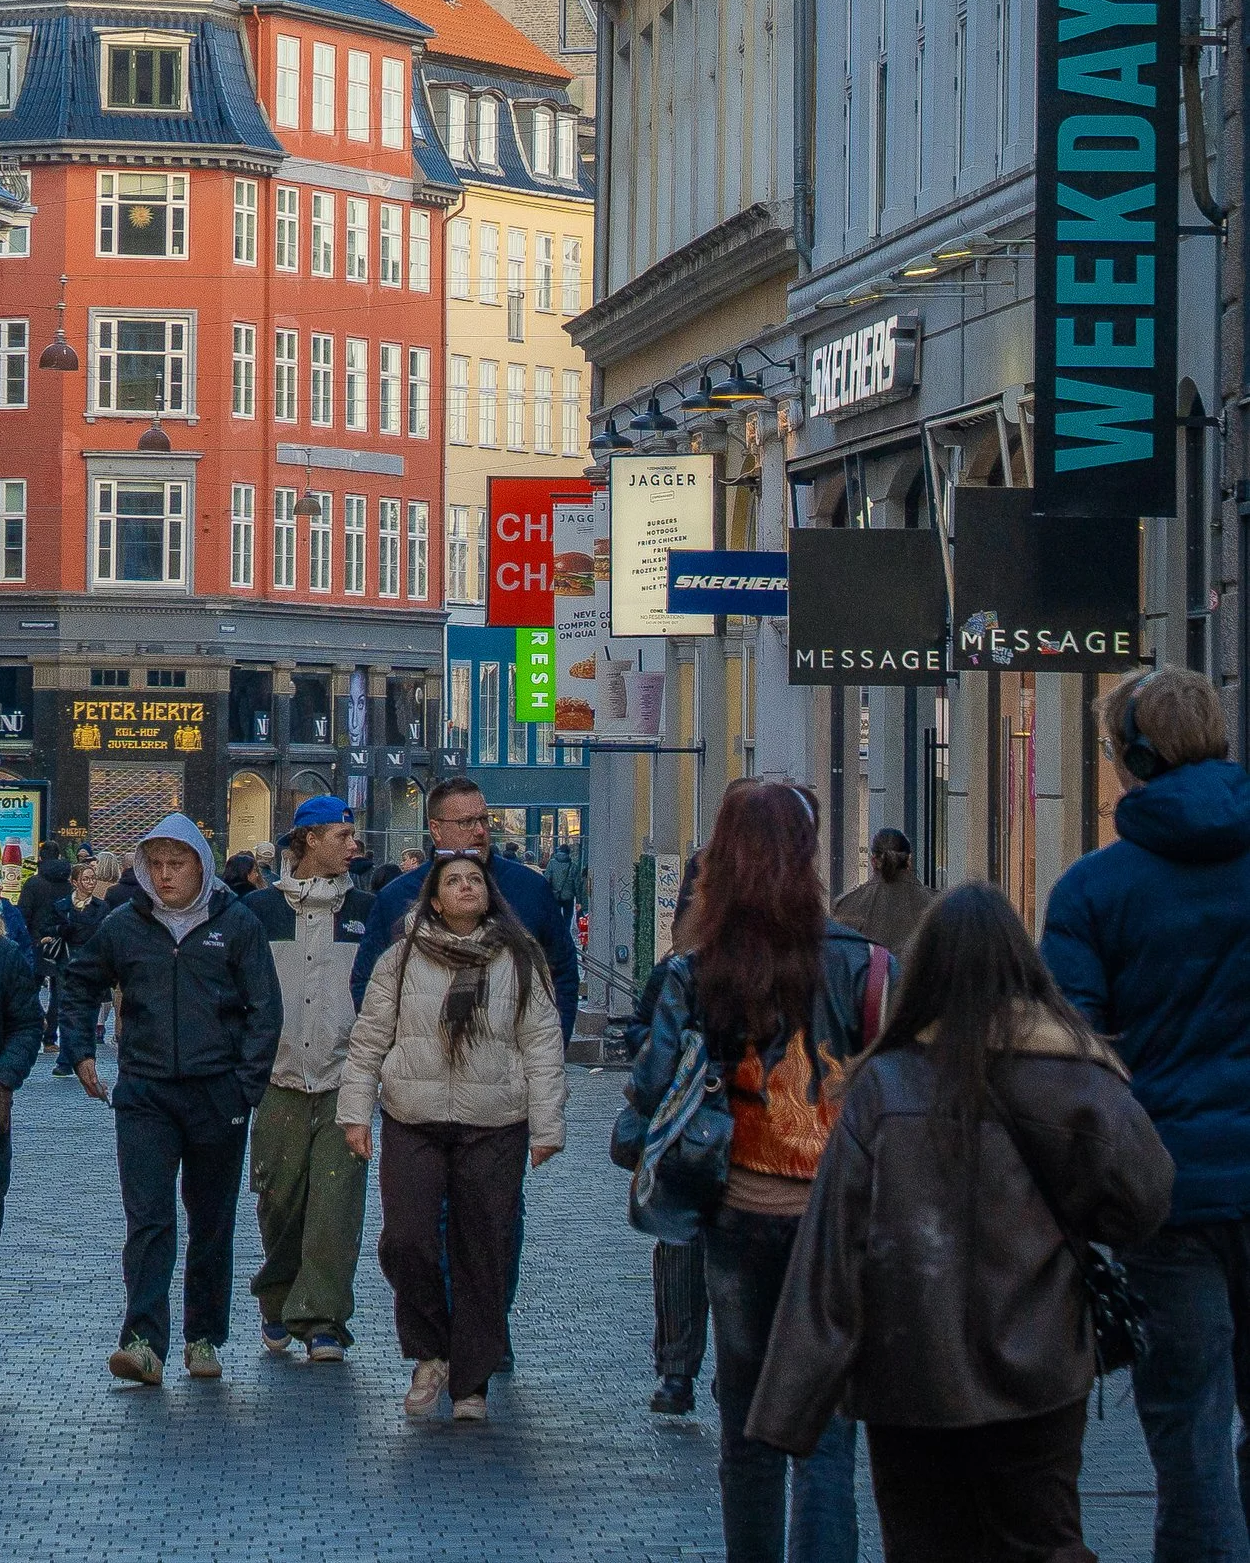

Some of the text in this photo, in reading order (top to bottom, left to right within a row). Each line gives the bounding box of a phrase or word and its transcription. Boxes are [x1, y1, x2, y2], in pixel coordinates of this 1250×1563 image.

[811, 315, 899, 418] SKECHERS
[628, 473, 697, 487] JAGGER
[496, 513, 554, 542] CH
[647, 518, 678, 527] BURGERS
[646, 527, 678, 536] HOTDOGS
[658, 535, 688, 544] CHICKEN
[496, 562, 554, 591] CH
[632, 567, 657, 575] FROZEN
[559, 631, 573, 640] ON
[961, 629, 1130, 654] MESSAGE
[795, 650, 940, 670] MESSAGE
[73, 701, 204, 722] PETER HERTZ
[0, 710, 26, 732] NÜ
[107, 740, 168, 750] JUVELERER
